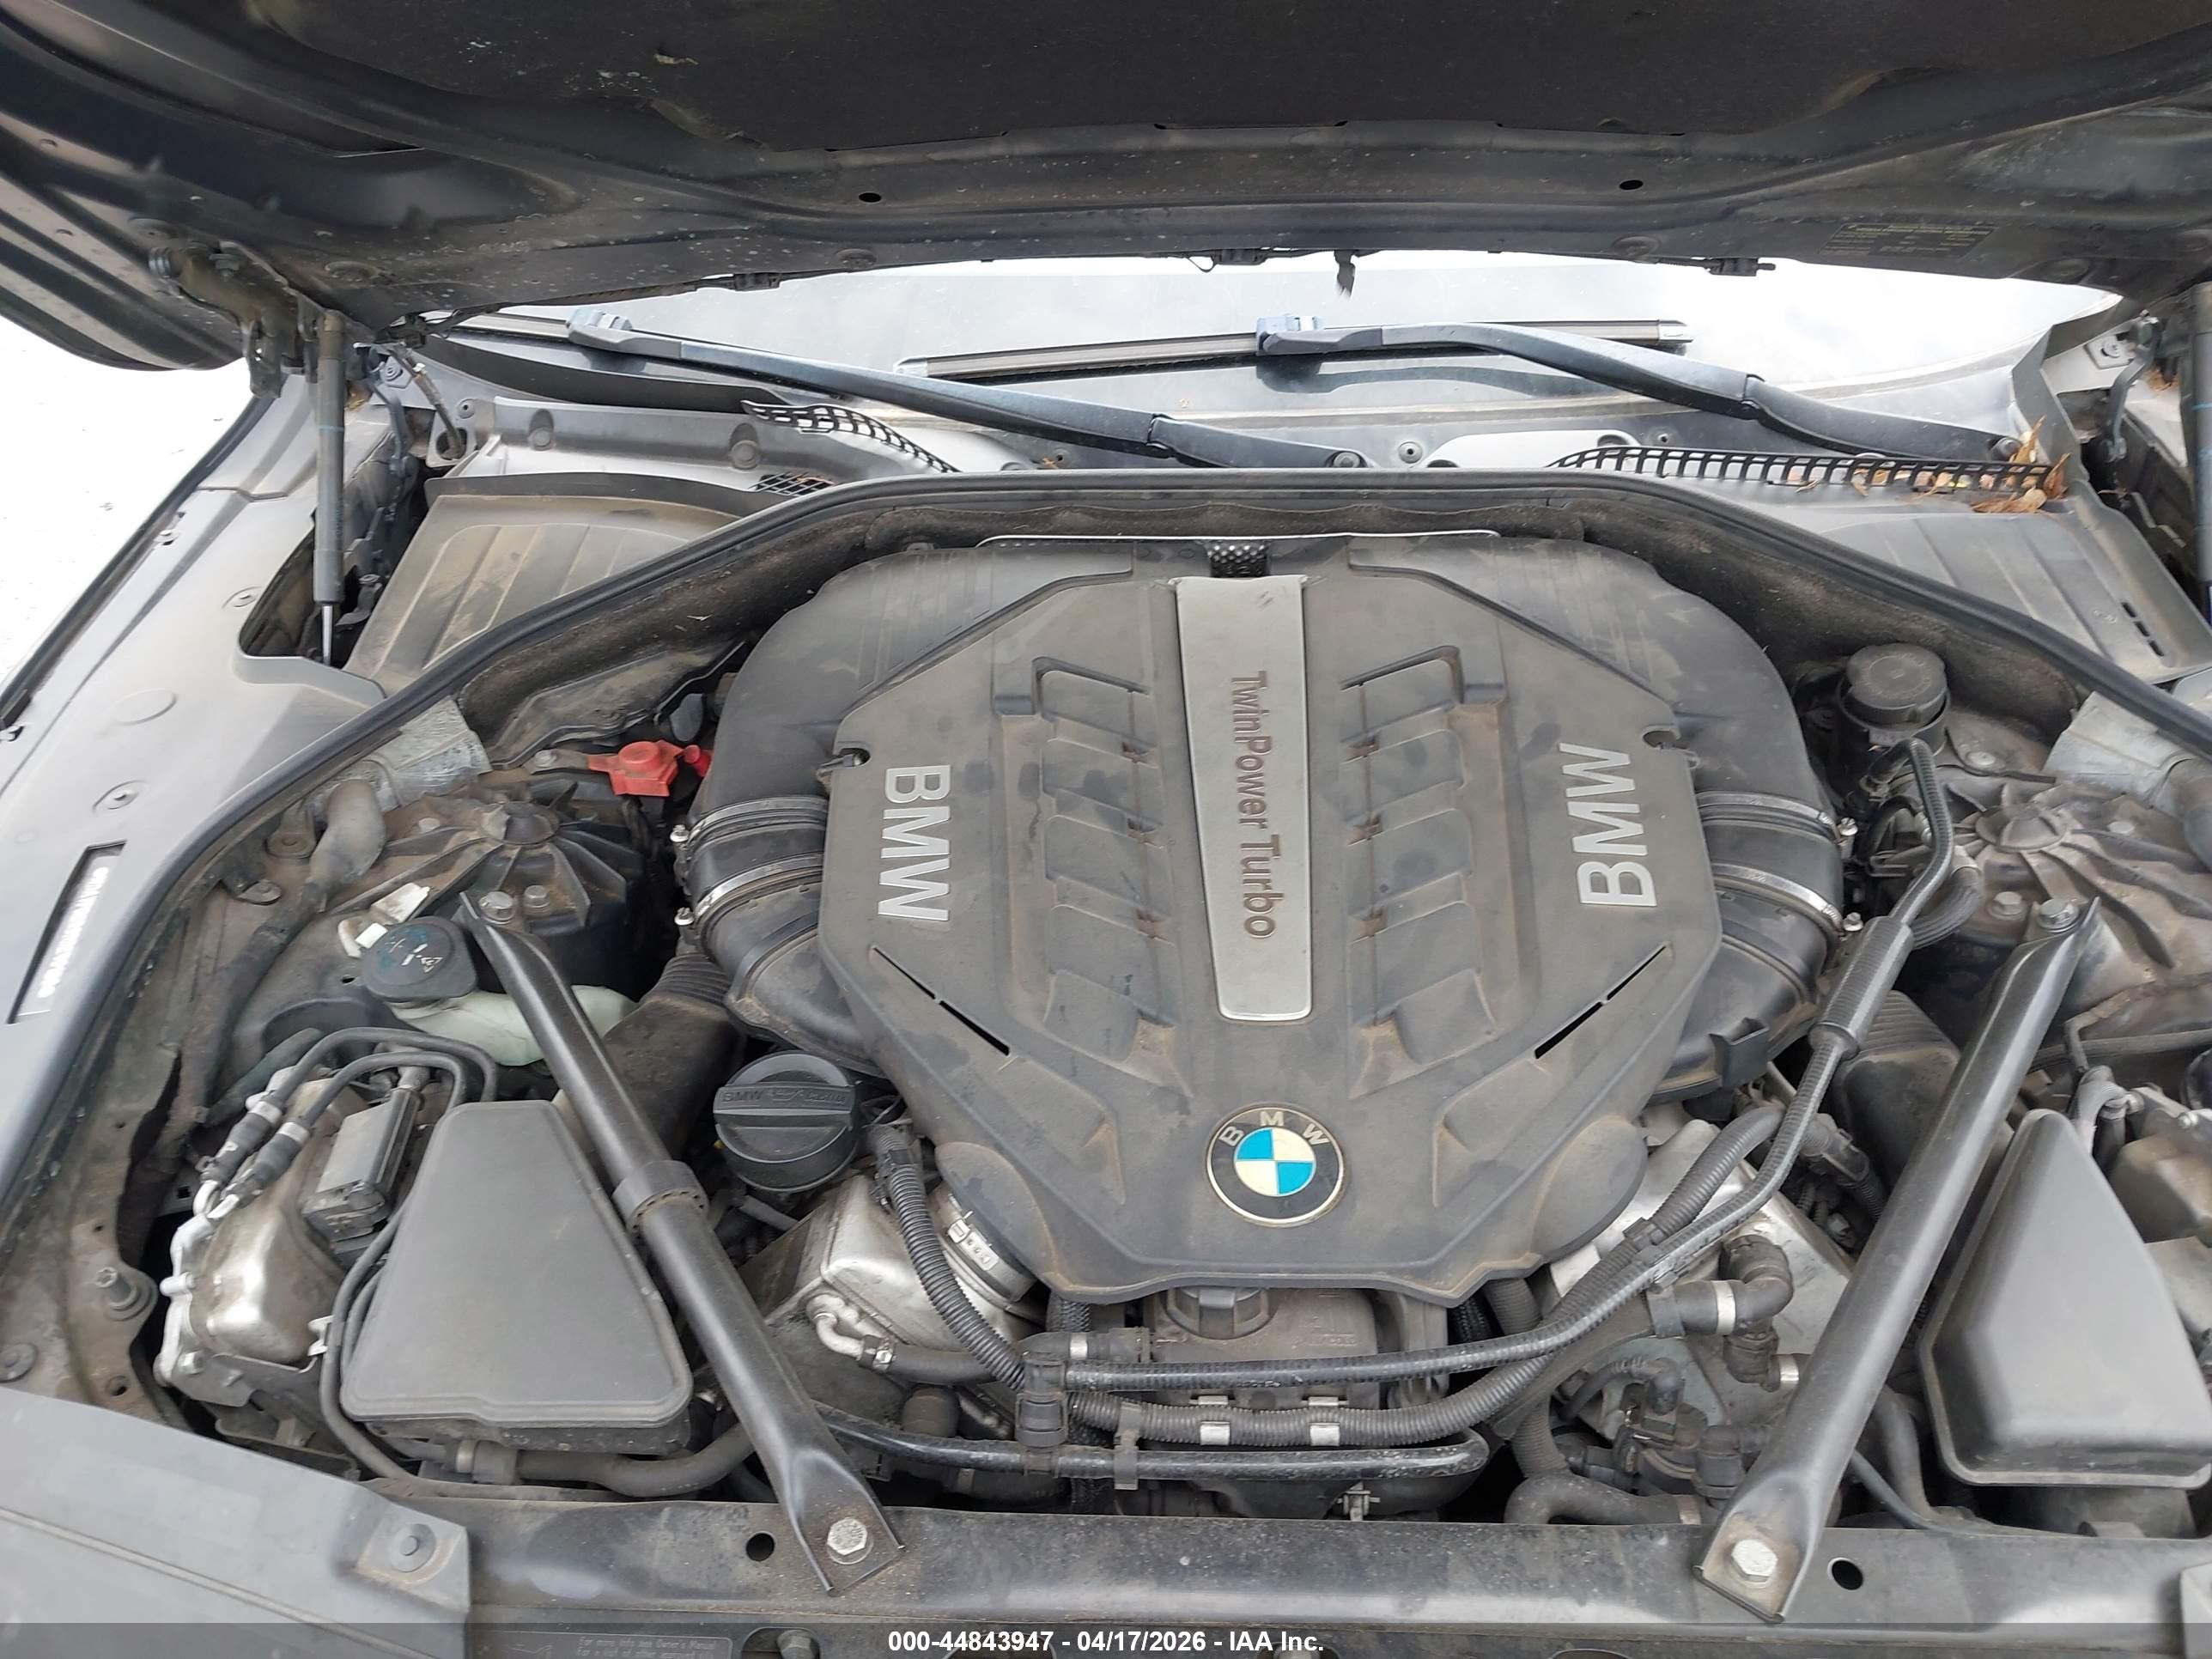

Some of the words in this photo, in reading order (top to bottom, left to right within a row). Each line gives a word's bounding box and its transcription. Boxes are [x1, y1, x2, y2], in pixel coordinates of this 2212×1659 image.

[1231, 671, 1273, 830] TwinPower
[1559, 743, 1656, 907] BMW
[878, 764, 951, 921] BMW
[1241, 835, 1284, 939] Turbo
[1218, 1111, 1330, 1146] BMW
